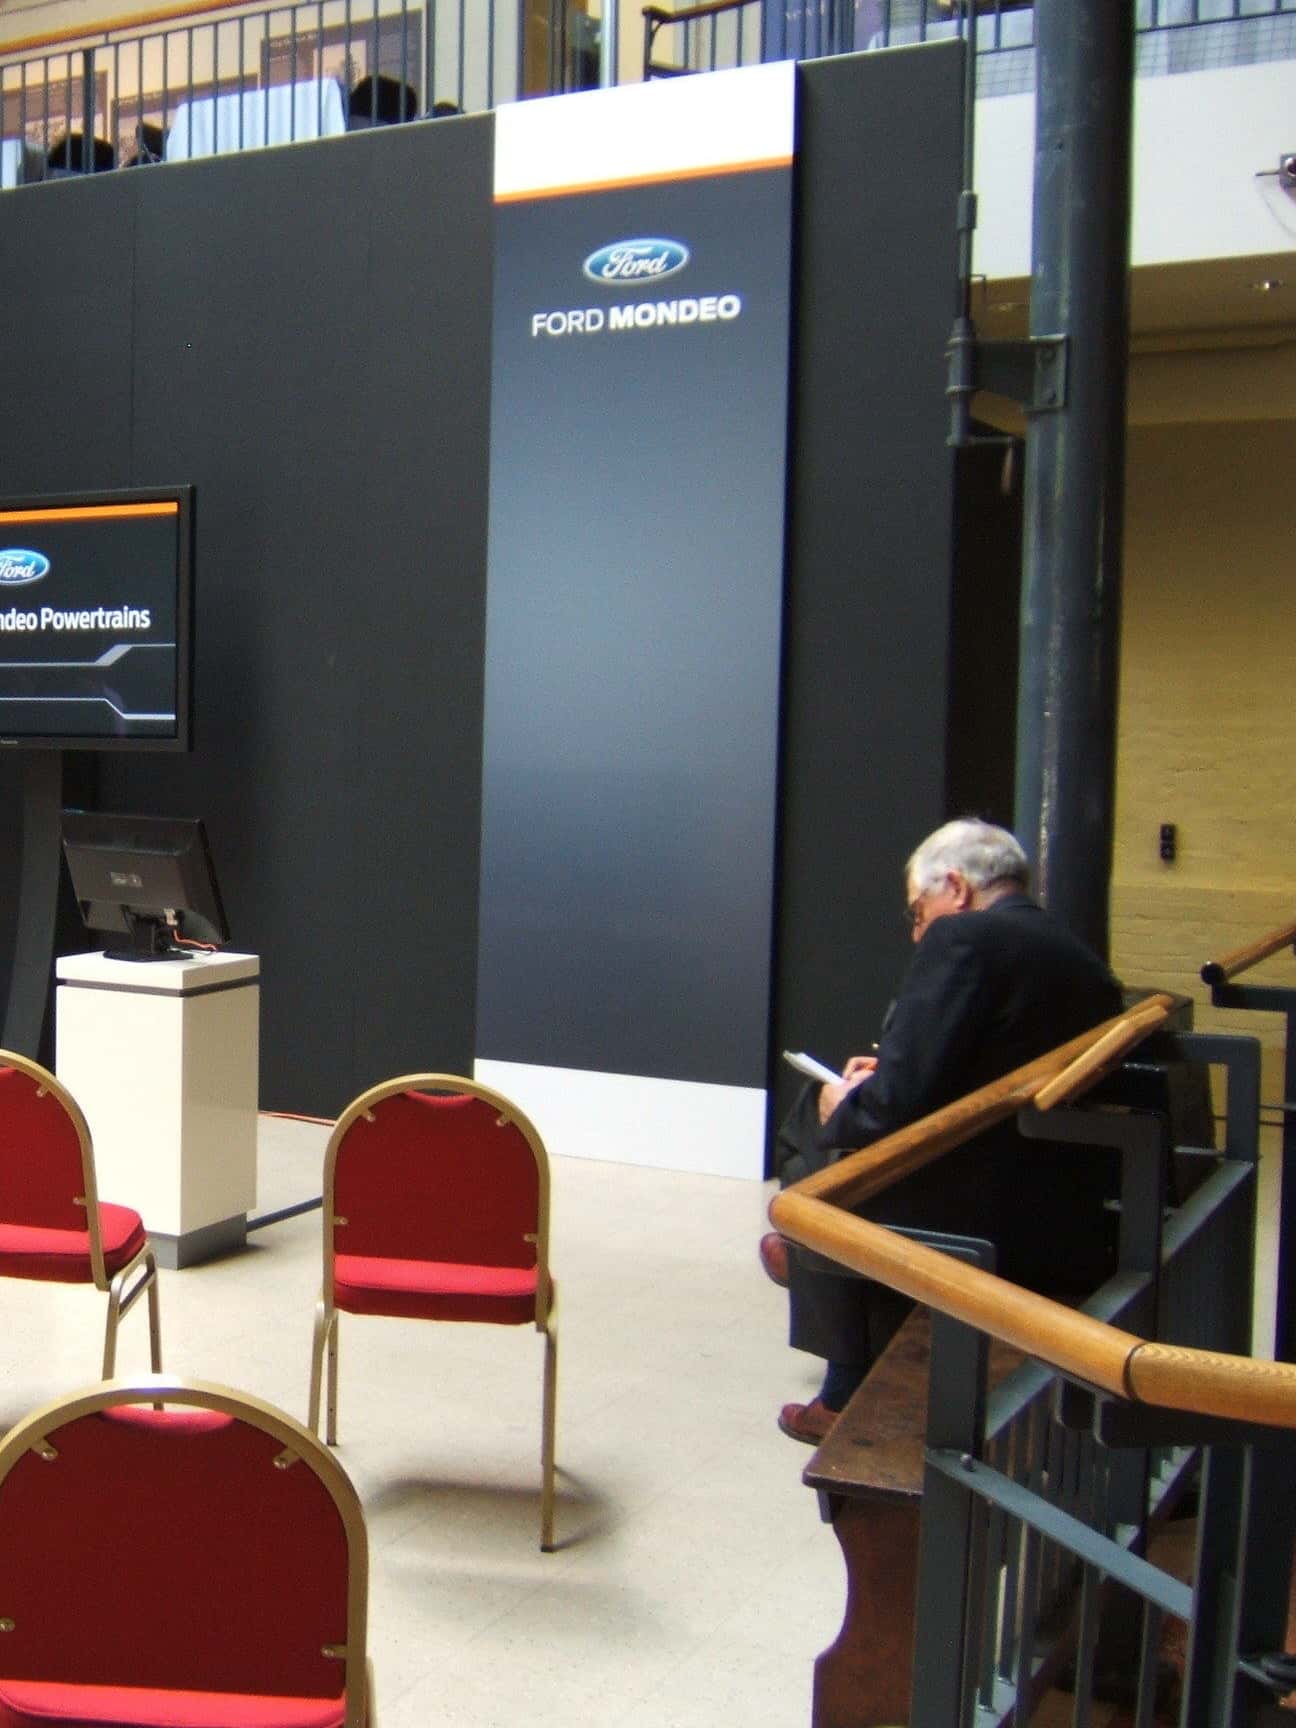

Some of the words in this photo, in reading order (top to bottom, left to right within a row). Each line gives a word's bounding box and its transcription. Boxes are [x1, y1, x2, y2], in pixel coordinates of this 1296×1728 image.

[601, 246, 668, 279] Ford
[531, 309, 605, 337] FORD
[609, 295, 742, 329] MONDEO
[40, 606, 151, 630] Powertrains
